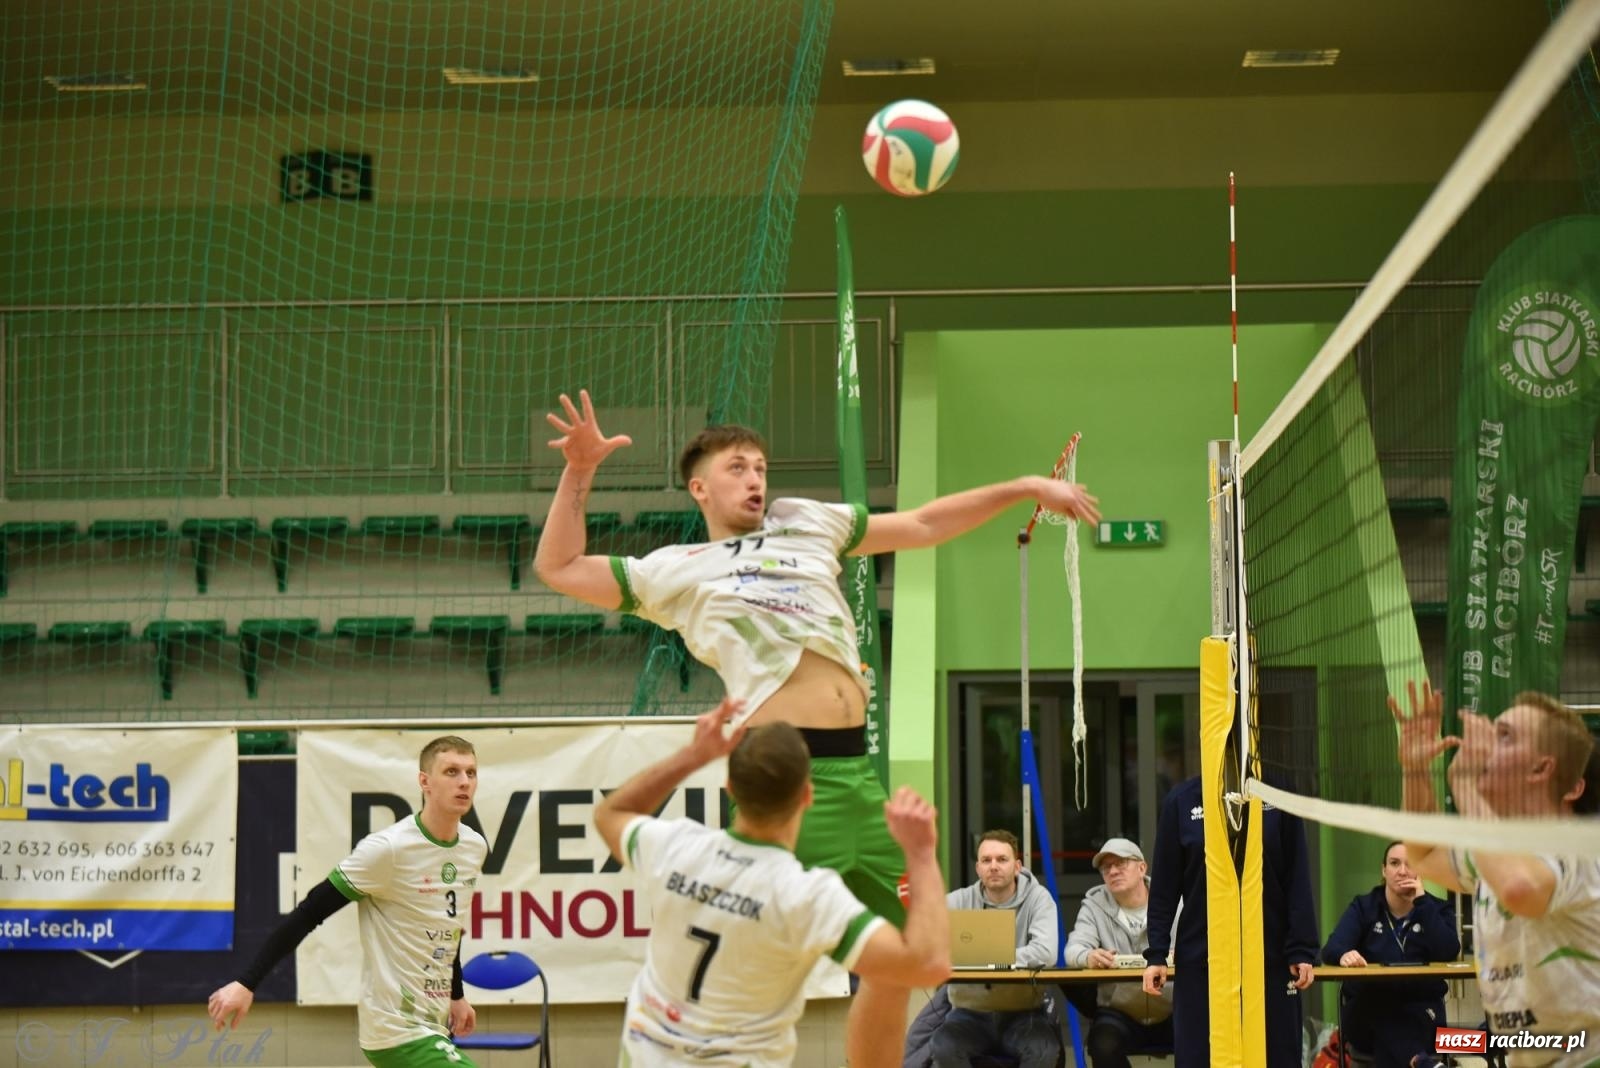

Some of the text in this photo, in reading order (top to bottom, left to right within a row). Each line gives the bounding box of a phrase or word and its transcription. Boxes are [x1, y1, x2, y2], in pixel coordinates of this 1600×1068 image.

[1497, 291, 1599, 357] KLUB SIATKARSKI
[1500, 362, 1578, 399] RACIBÓRZ
[1463, 418, 1504, 713] LUB SIATKARSKI
[1492, 494, 1528, 679] RACIBÓRZ
[0, 758, 170, 822] l-tech
[0, 841, 215, 858] 2 632 695, 606 363 647
[32, 868, 65, 881] von
[71, 866, 185, 882] Eichendorffa
[192, 867, 202, 881] 2
[446, 889, 457, 918] 3
[667, 871, 764, 922] BŁASZCZOK
[687, 925, 721, 1004] 7
